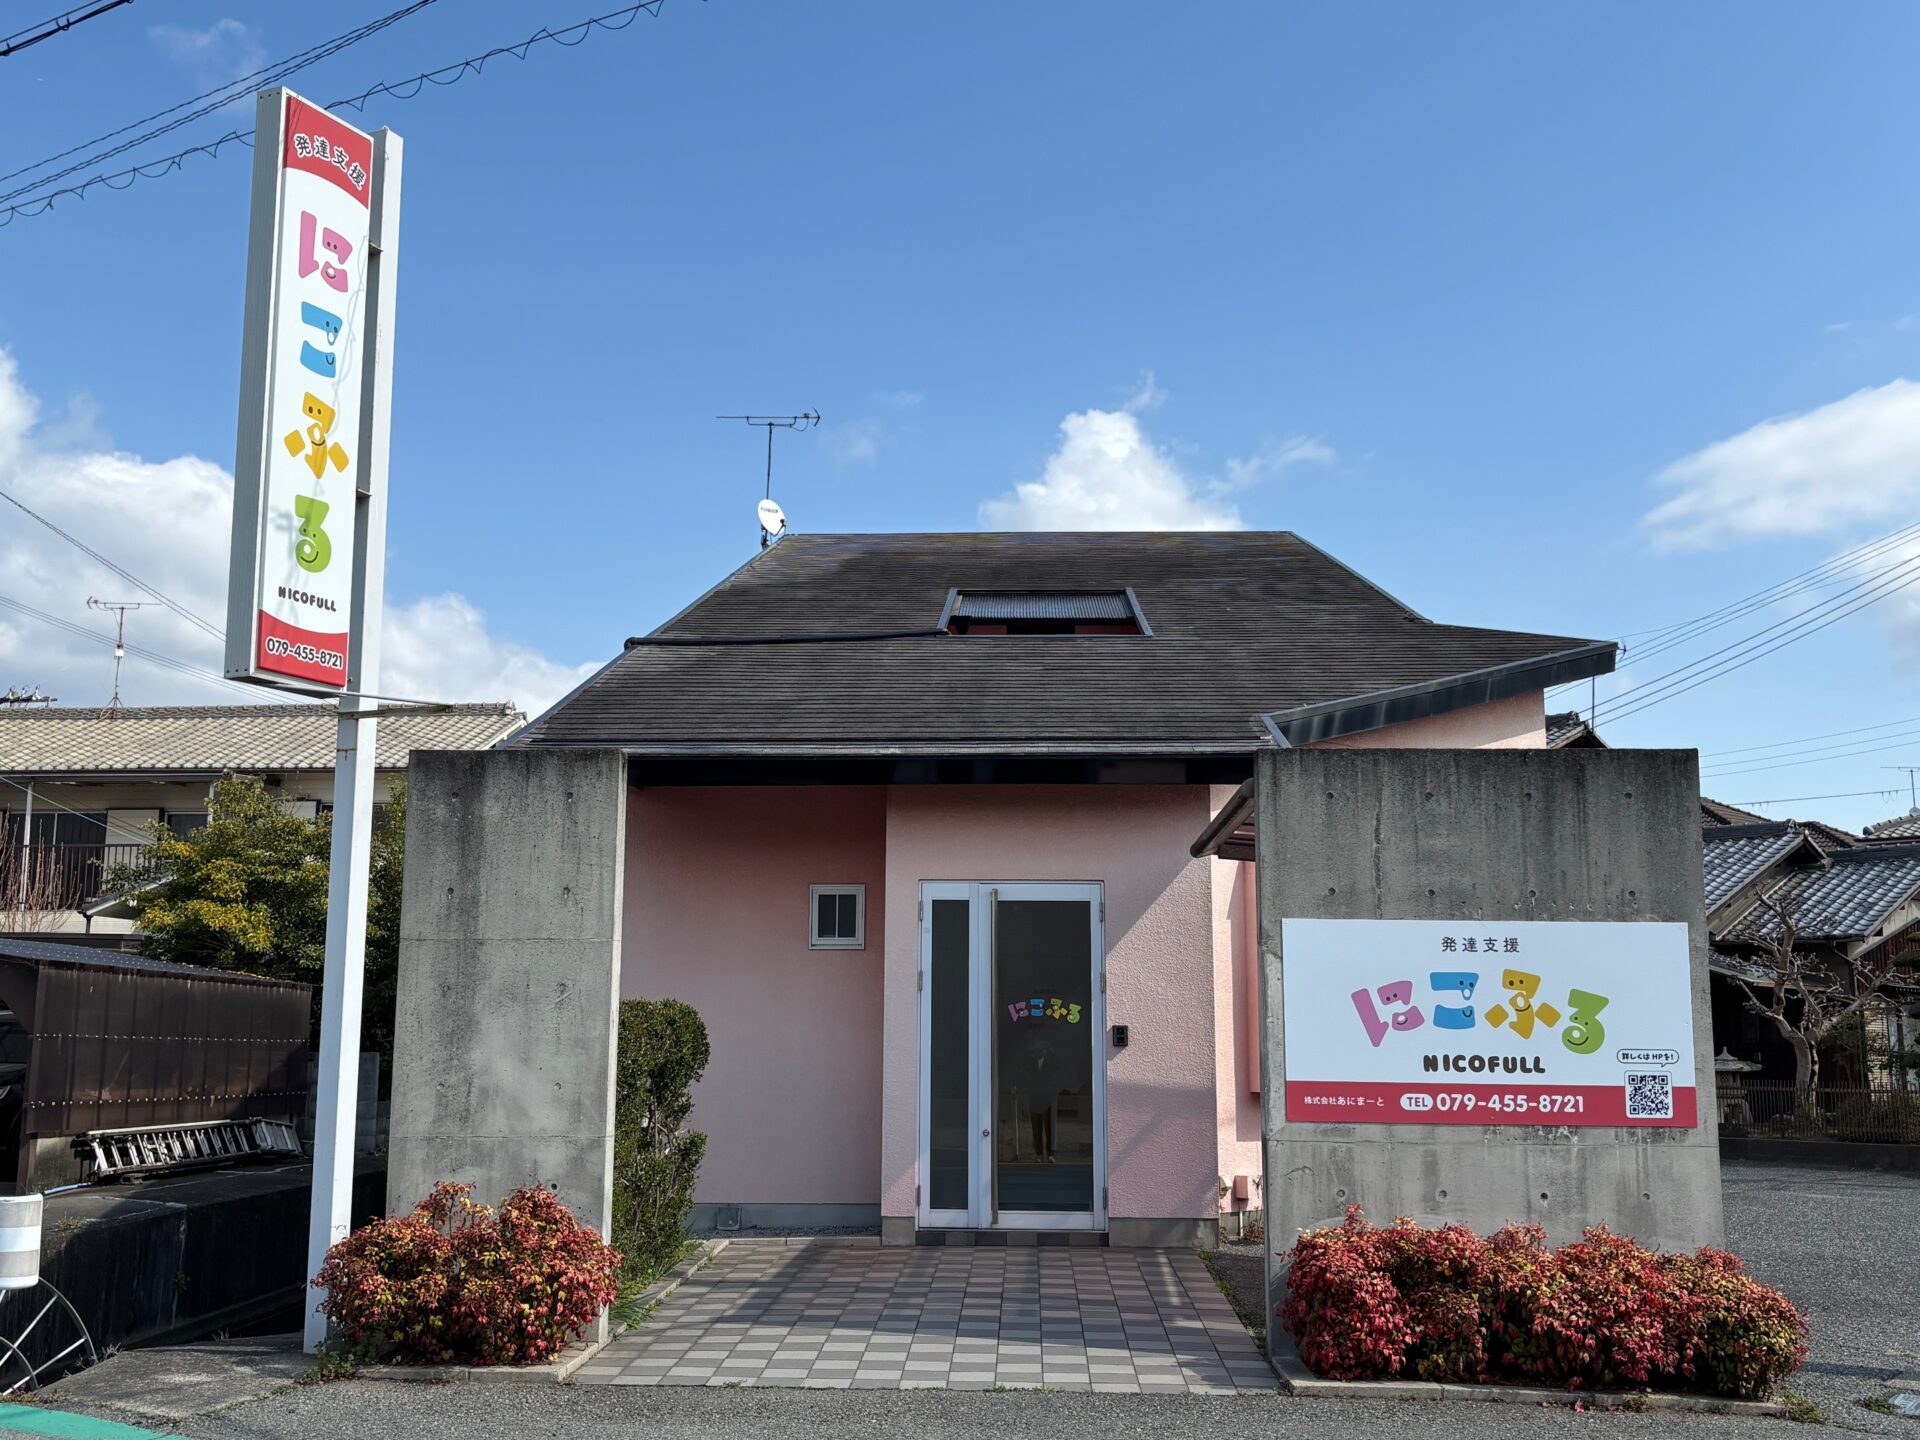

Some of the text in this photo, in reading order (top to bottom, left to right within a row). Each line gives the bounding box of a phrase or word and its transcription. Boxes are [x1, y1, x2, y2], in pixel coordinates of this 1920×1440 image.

[295, 135, 366, 189] 発達支援
[284, 210, 353, 573] にこふる
[278, 586, 337, 612] NICOFULL
[266, 638, 344, 669] 079-455-8721
[1441, 936, 1520, 954] 発達支援
[1007, 997, 1082, 1024] にこふる
[1351, 968, 1609, 1055] にこふる
[1423, 1054, 1546, 1074] NICOFULL
[1304, 1096, 1385, 1107] 株式会社あにまーと
[1406, 1093, 1584, 1113] TEL 079-455-8721
